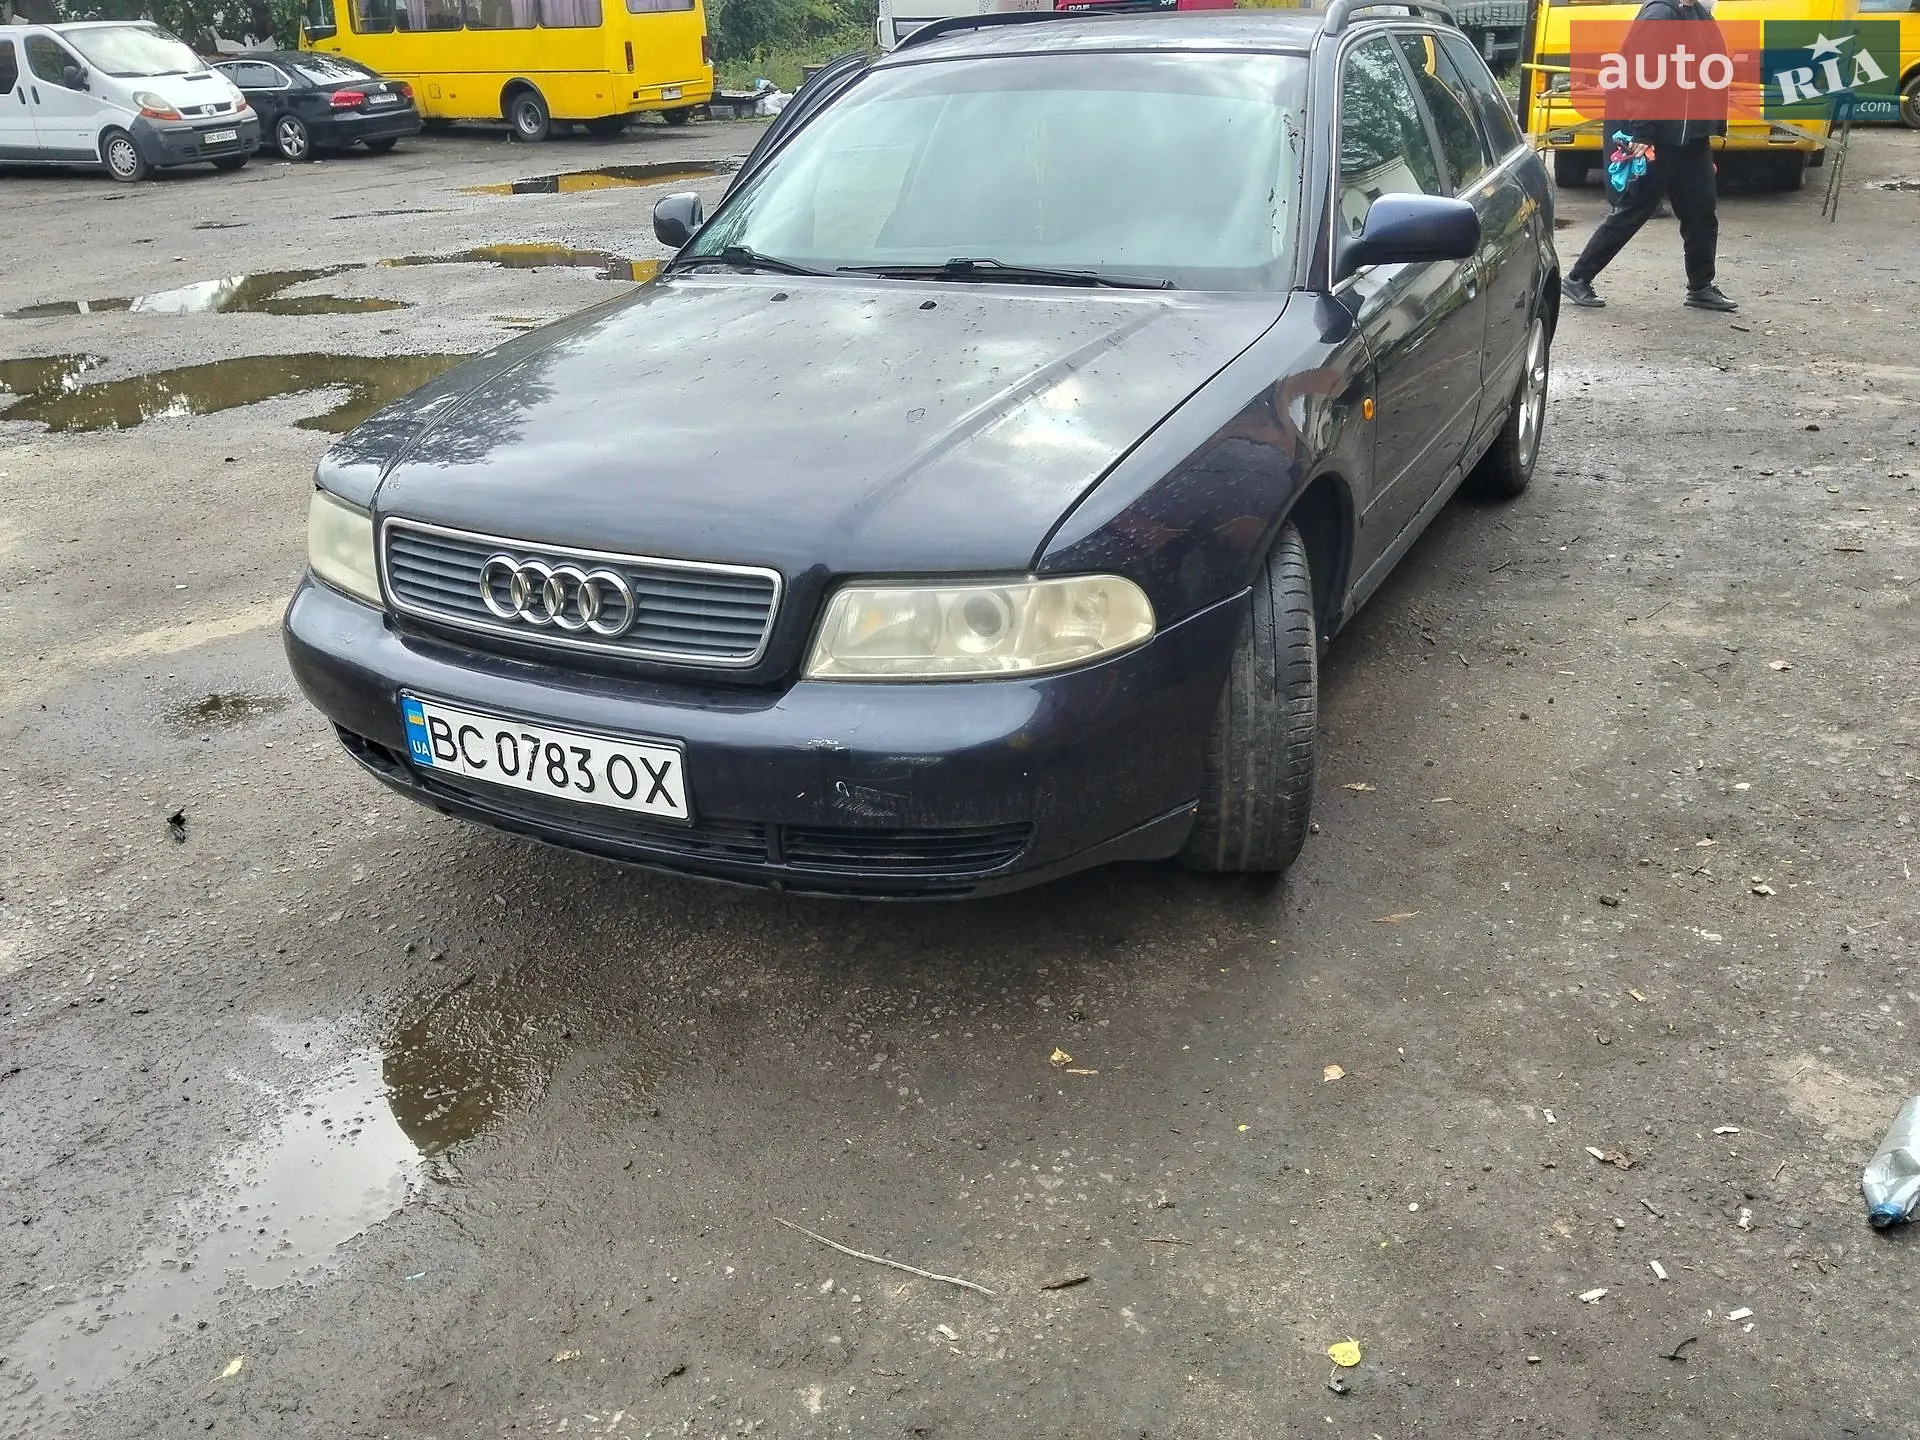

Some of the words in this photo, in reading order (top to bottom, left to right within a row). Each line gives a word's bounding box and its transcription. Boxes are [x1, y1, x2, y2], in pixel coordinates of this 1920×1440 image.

[411, 740, 432, 758] UA
[427, 715, 488, 770] BC
[495, 730, 596, 794] 0783
[606, 753, 678, 808] OX
